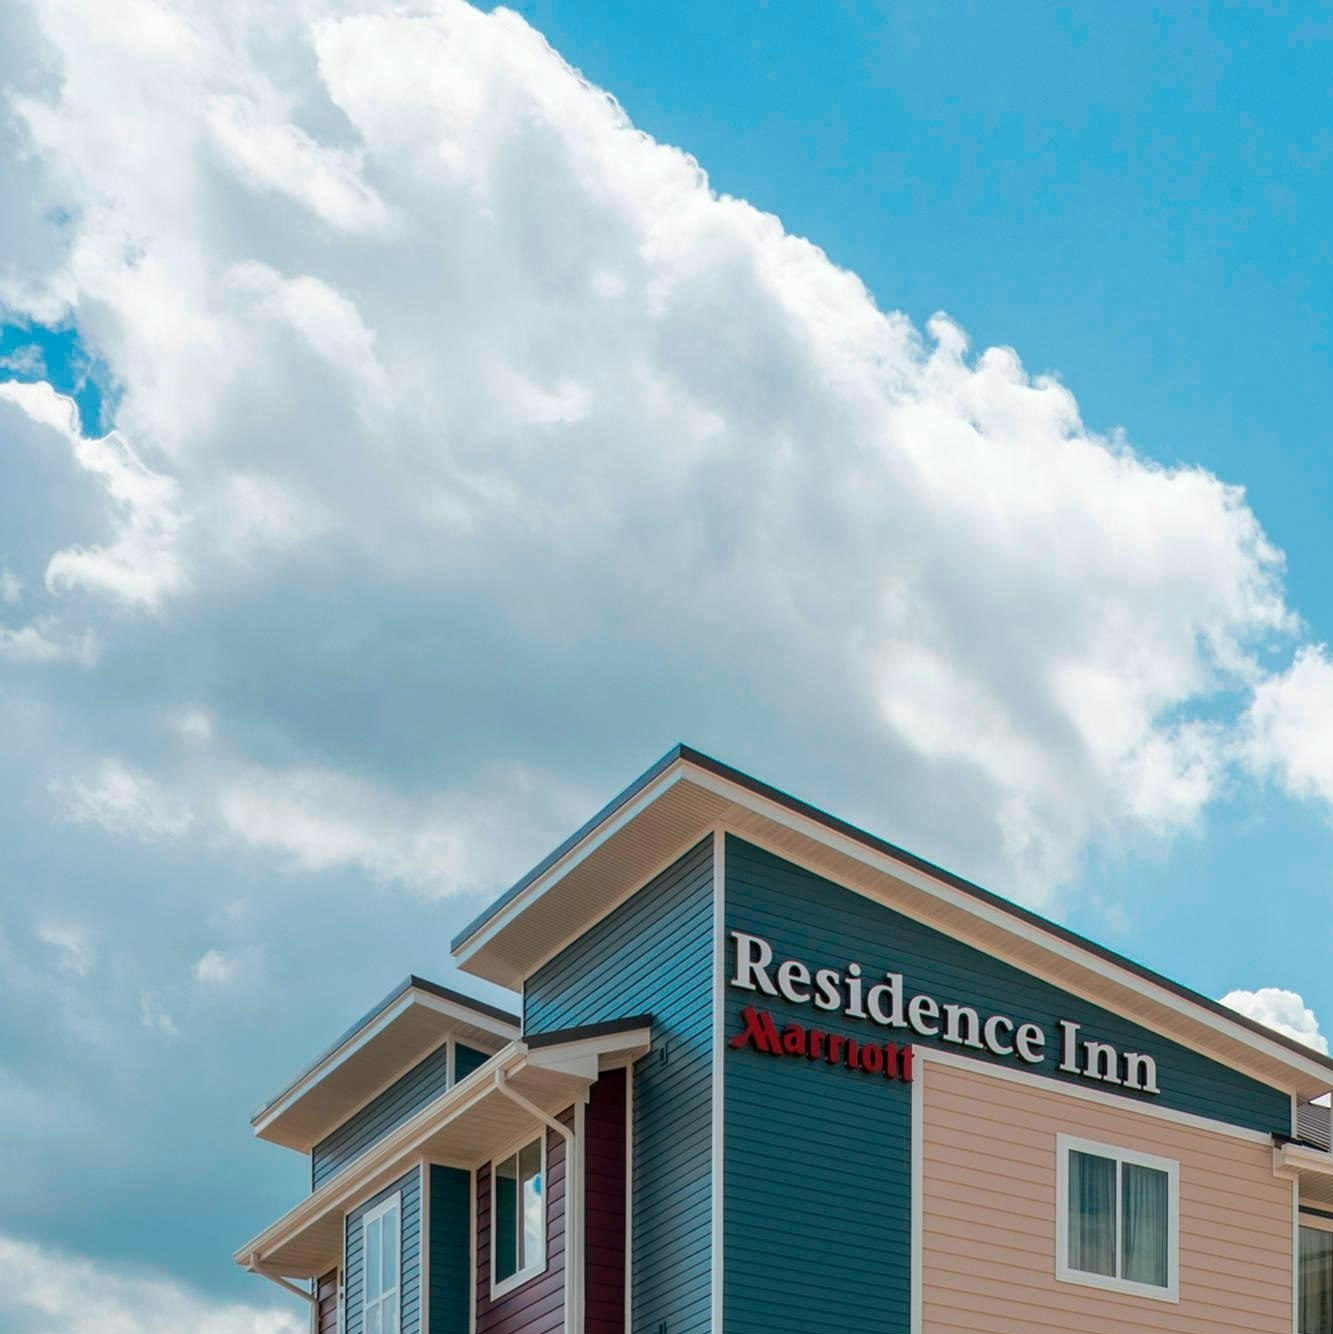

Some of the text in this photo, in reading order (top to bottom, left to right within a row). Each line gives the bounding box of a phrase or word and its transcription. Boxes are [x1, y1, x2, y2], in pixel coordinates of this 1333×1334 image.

[730, 931, 1161, 1095] Residence Inn
[730, 1005, 915, 1083] Marriott
